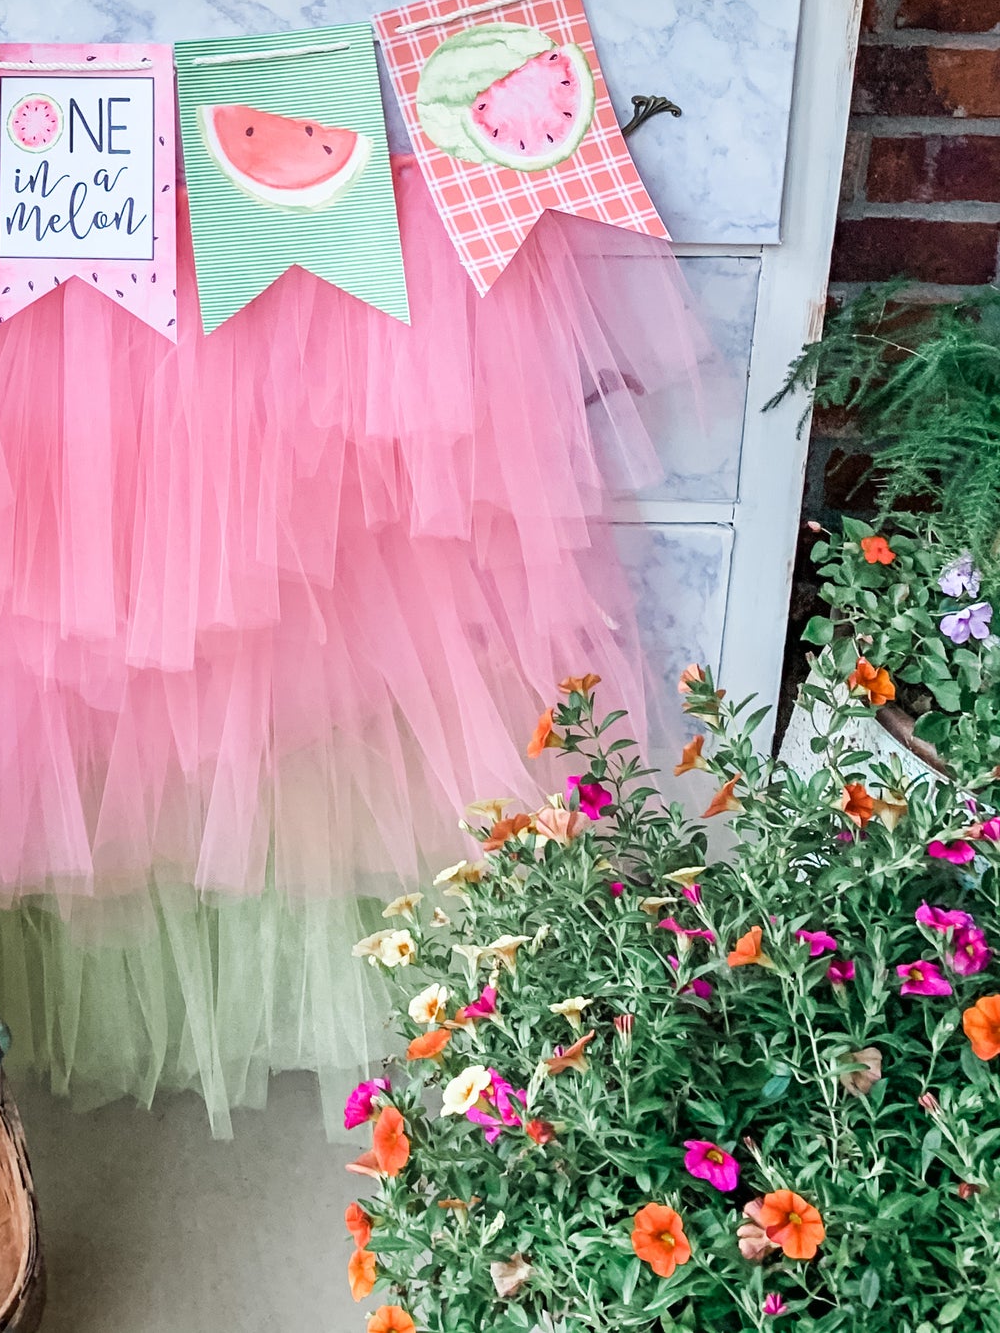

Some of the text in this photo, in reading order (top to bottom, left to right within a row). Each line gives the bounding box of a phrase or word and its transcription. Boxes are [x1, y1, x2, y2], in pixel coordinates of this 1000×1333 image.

[14, 160, 128, 198] in a
[6, 182, 147, 241] melon
